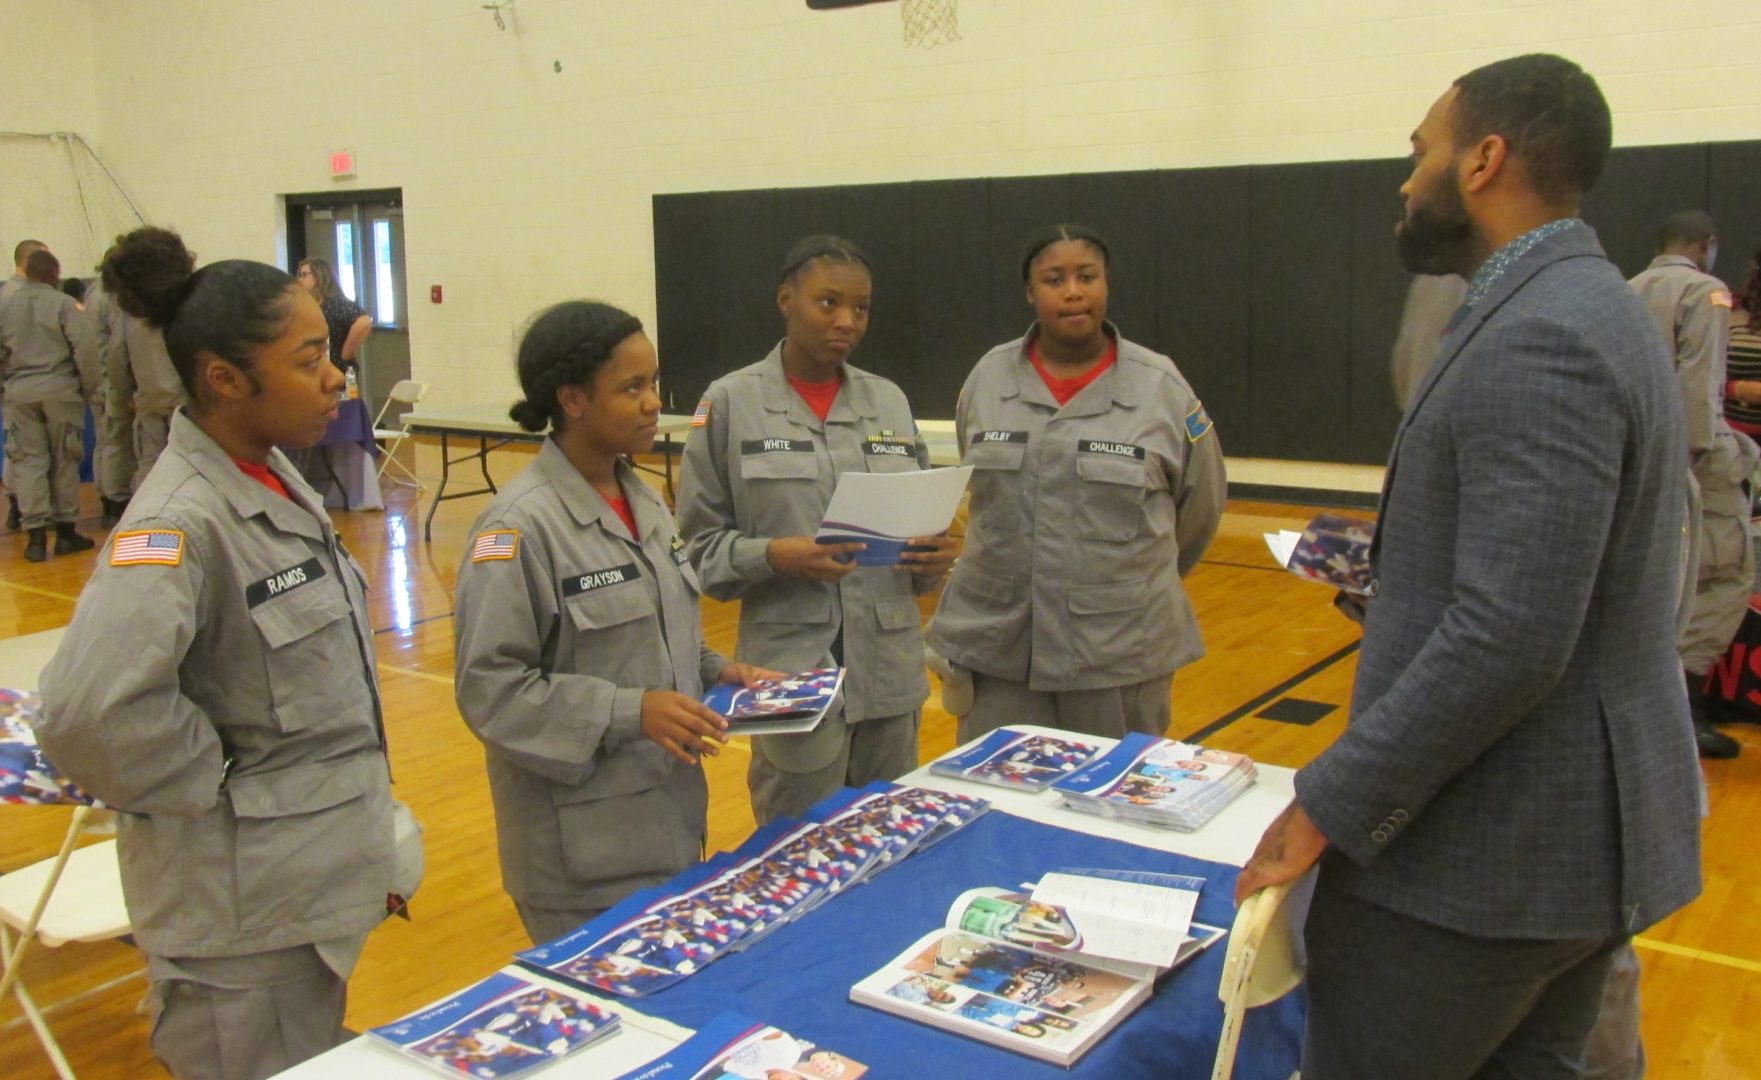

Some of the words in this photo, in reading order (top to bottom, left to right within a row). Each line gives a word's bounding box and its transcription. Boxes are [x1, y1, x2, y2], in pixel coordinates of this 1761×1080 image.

[983, 431, 1010, 441] SHELBY
[763, 439, 792, 450] WHITE
[871, 443, 908, 456] CHALLENGE
[1089, 442, 1135, 457] CHALLENGE
[266, 567, 307, 595] RAMOS
[580, 569, 625, 590] GRAYSON
